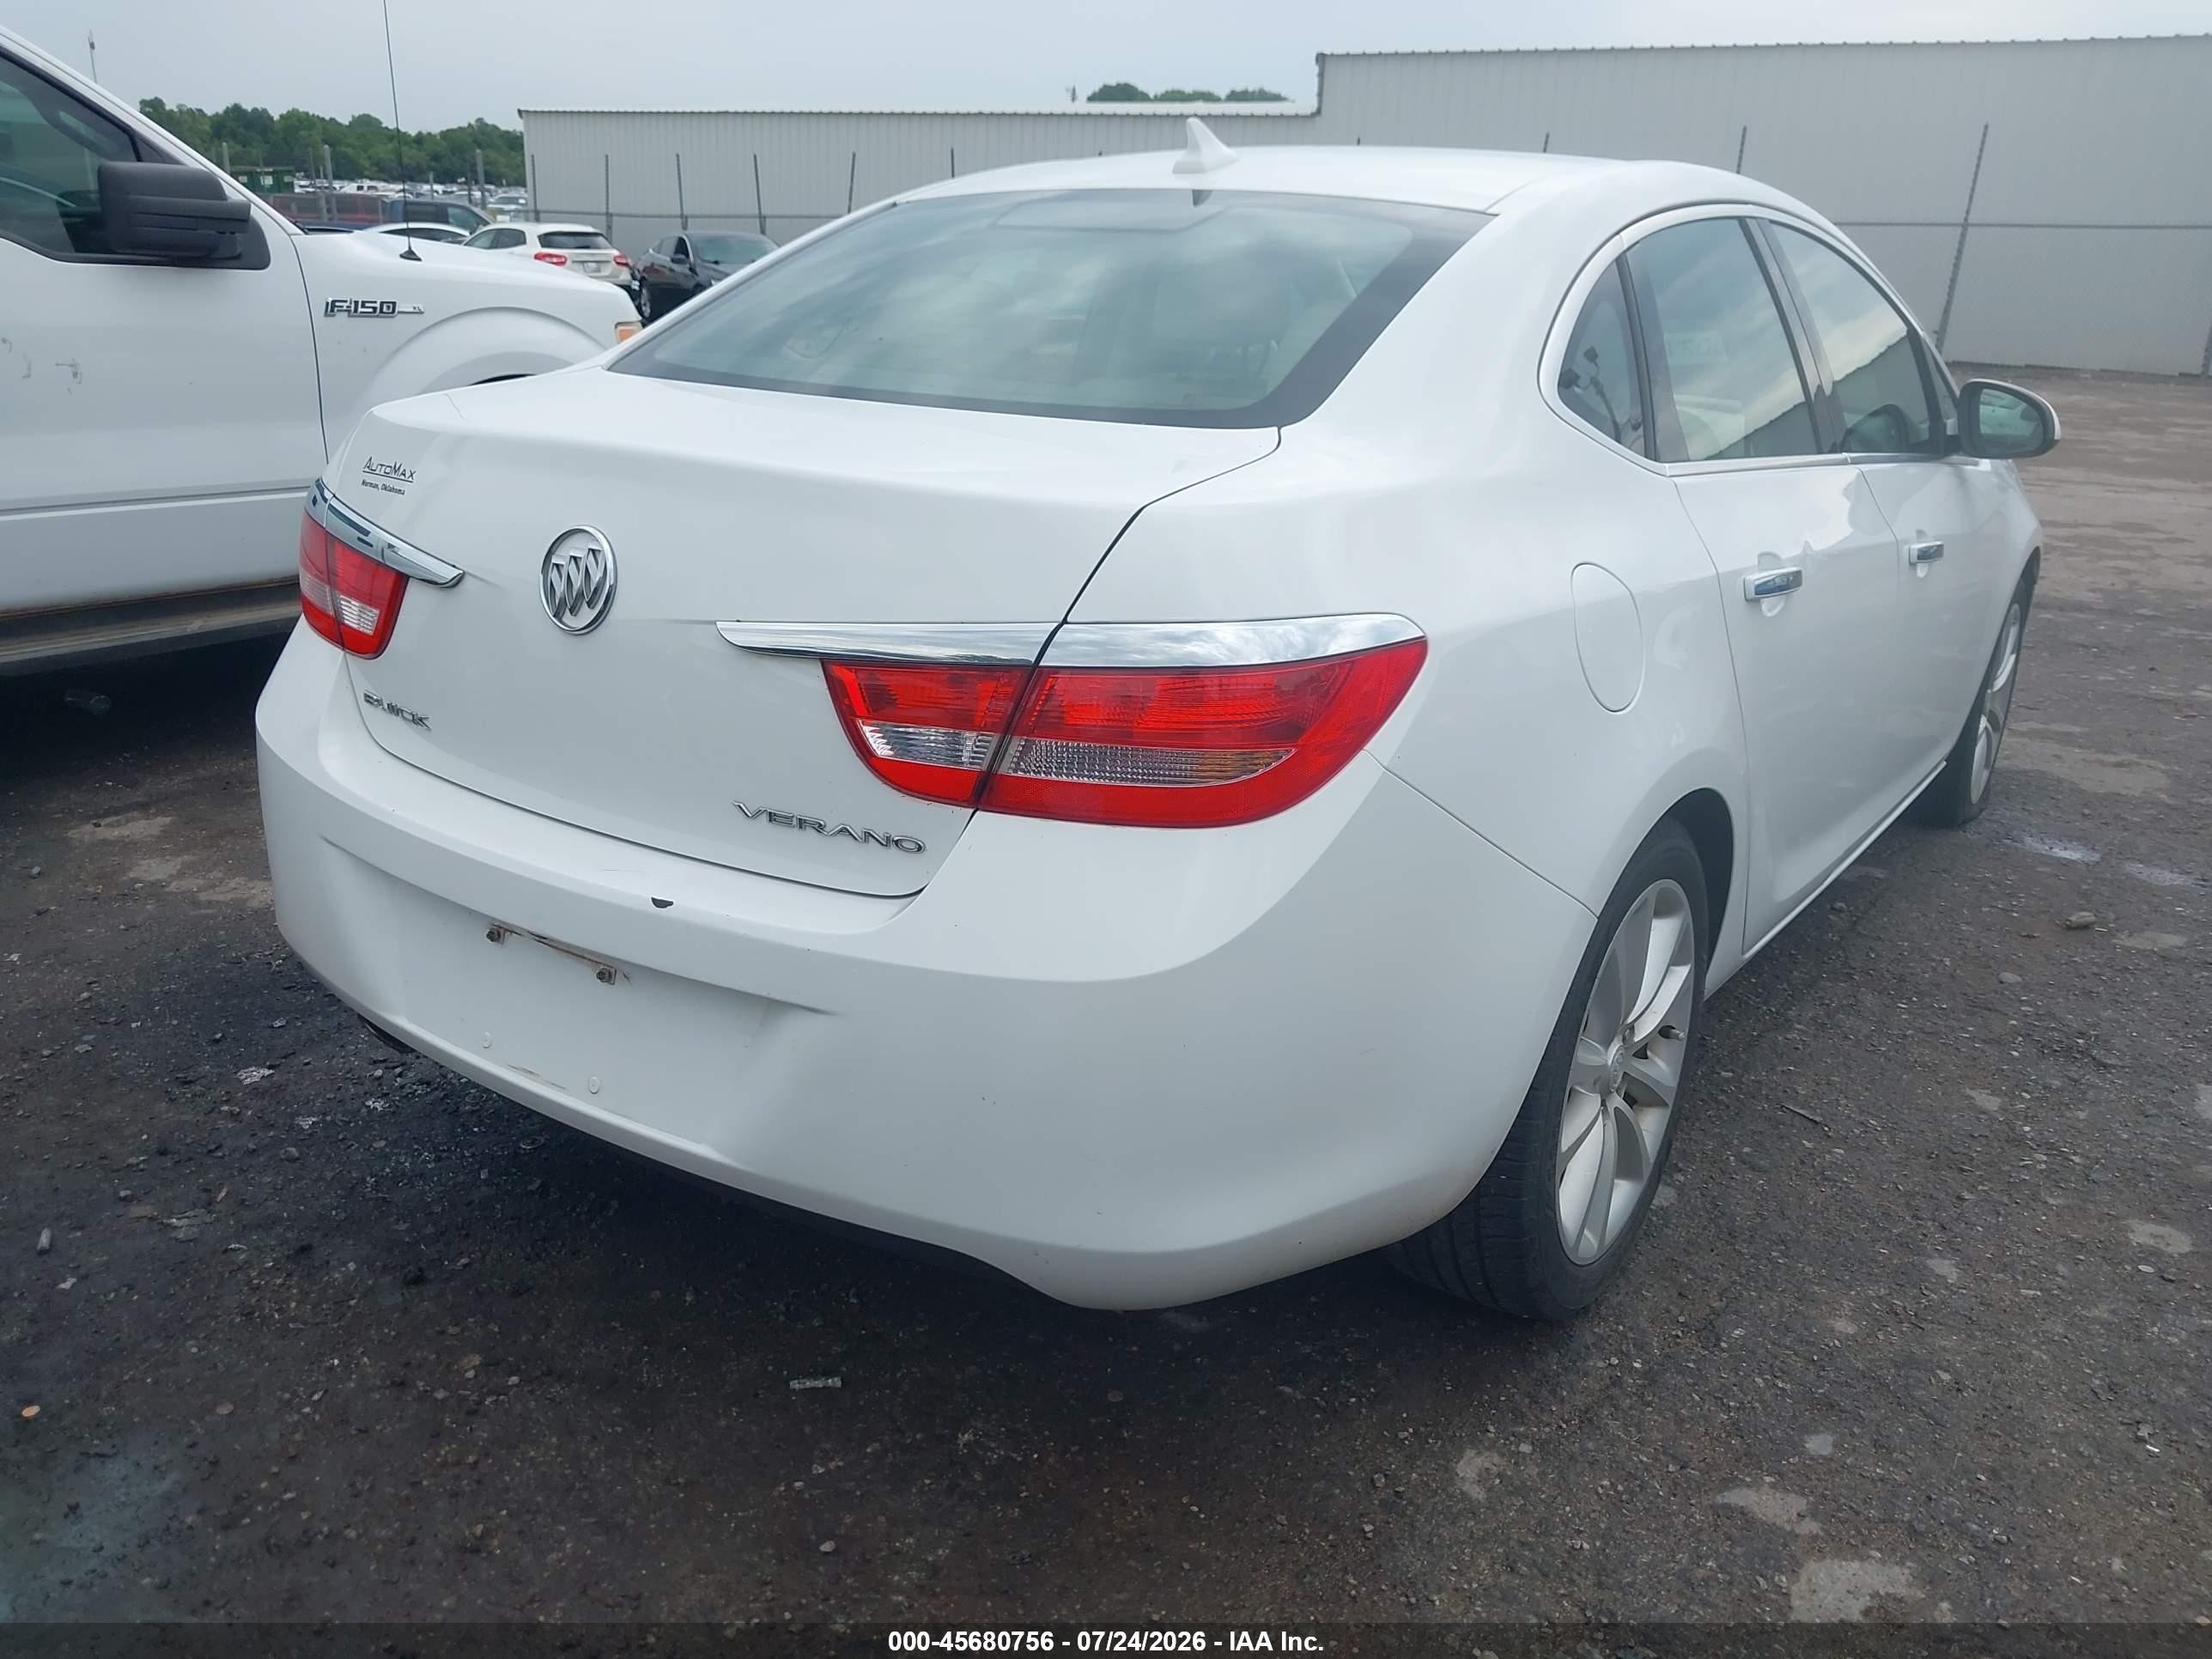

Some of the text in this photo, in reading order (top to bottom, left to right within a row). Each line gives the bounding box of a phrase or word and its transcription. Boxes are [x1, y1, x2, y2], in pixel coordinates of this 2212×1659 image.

[324, 298, 398, 318] F-150
[363, 690, 432, 732] BUICK
[732, 800, 927, 854] VERANO
